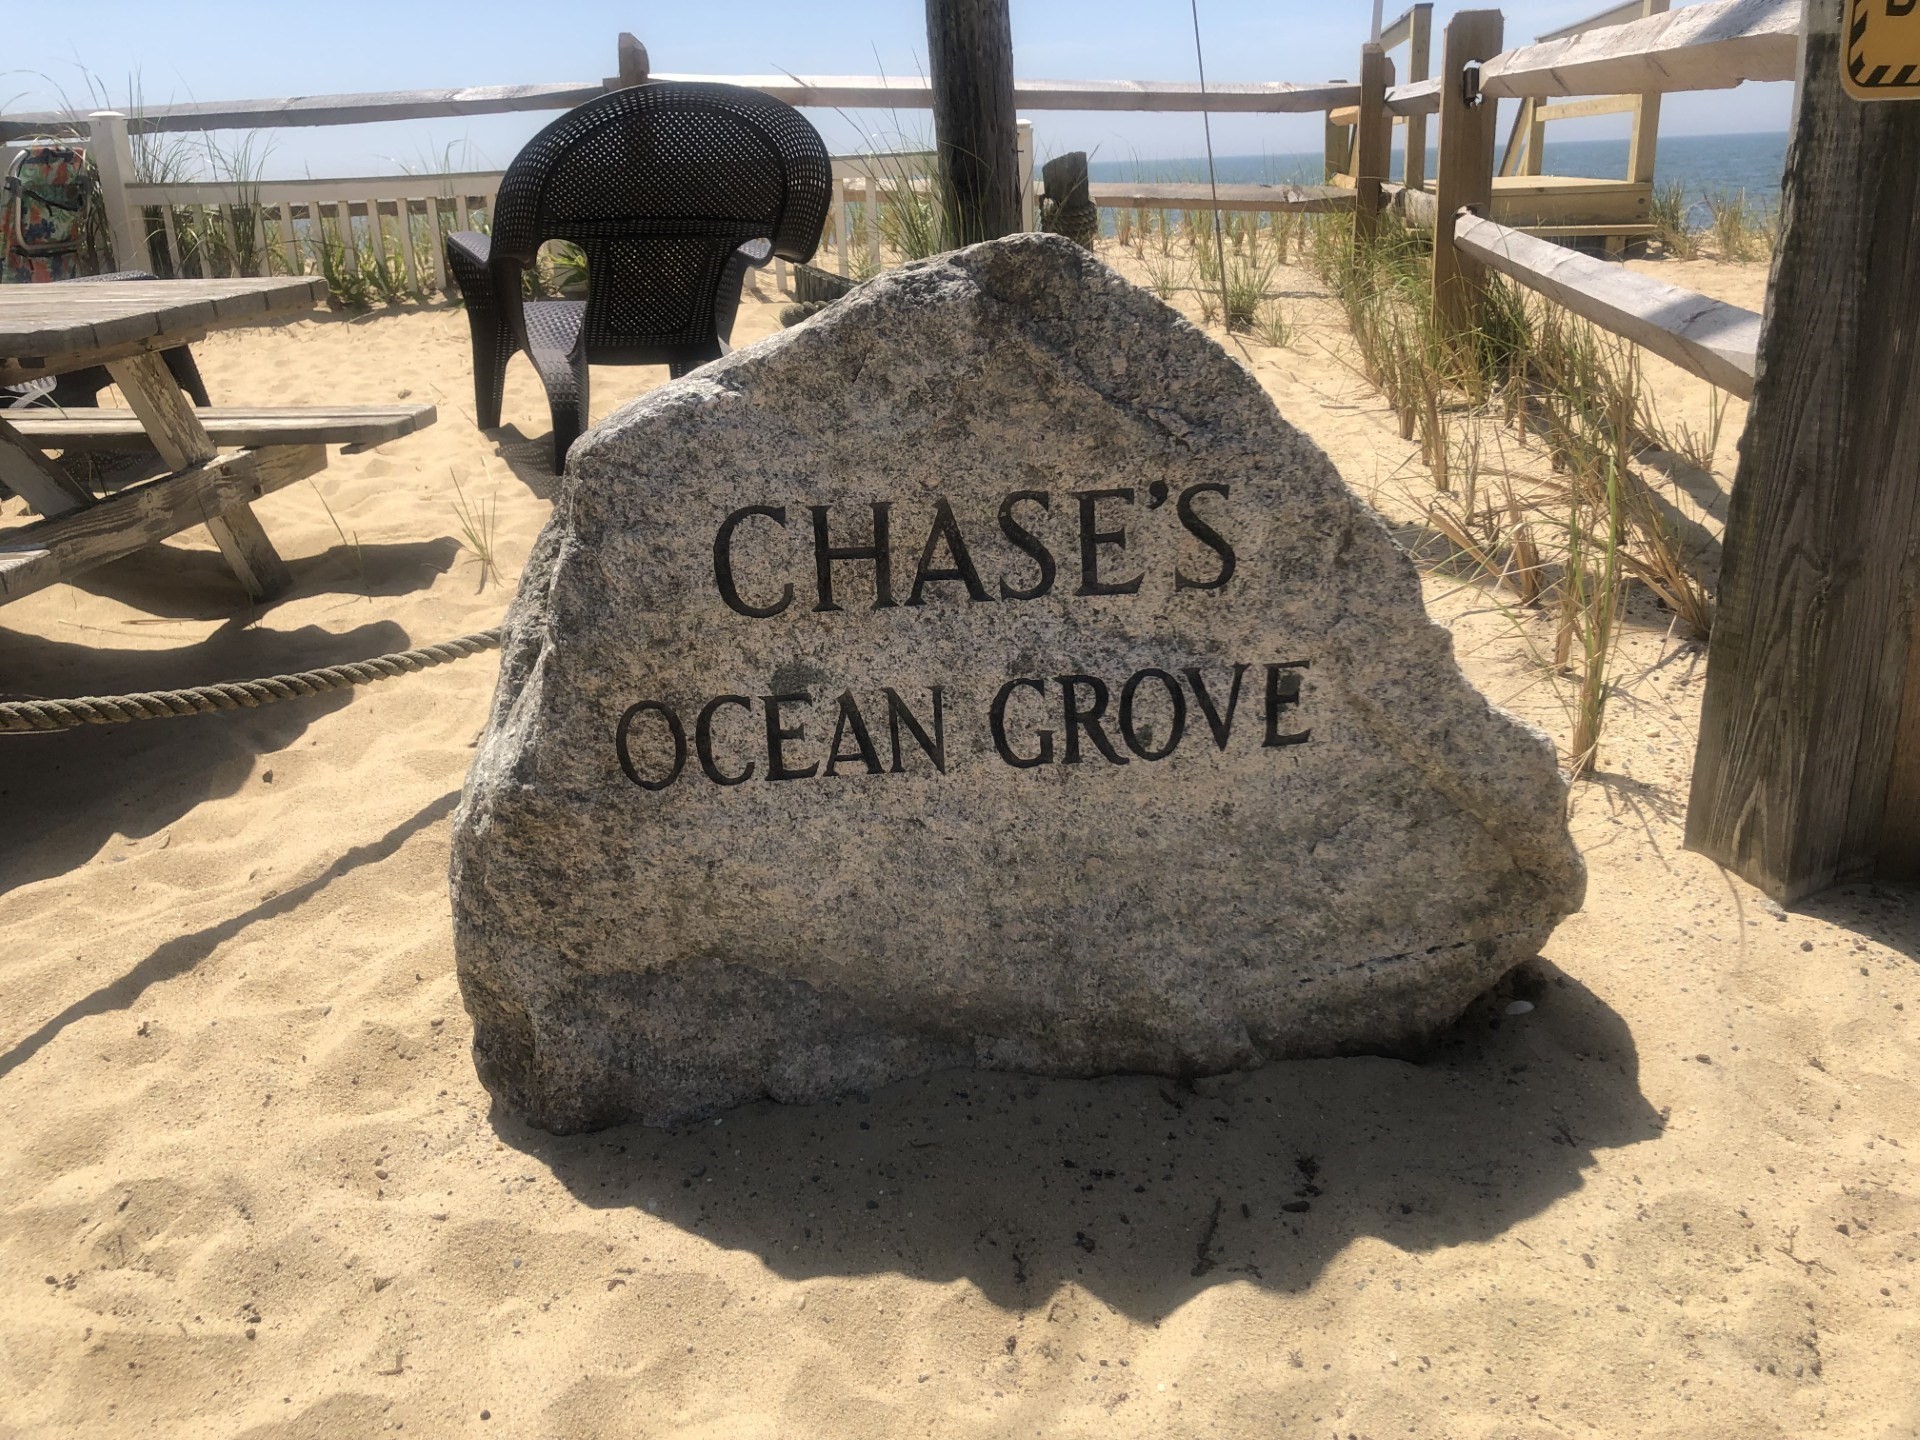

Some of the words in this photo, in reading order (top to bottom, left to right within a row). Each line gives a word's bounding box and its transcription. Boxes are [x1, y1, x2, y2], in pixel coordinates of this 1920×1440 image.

[713, 481, 1237, 618] CHASE'S
[615, 684, 947, 791] OCEAN
[989, 660, 1311, 768] GROVE
